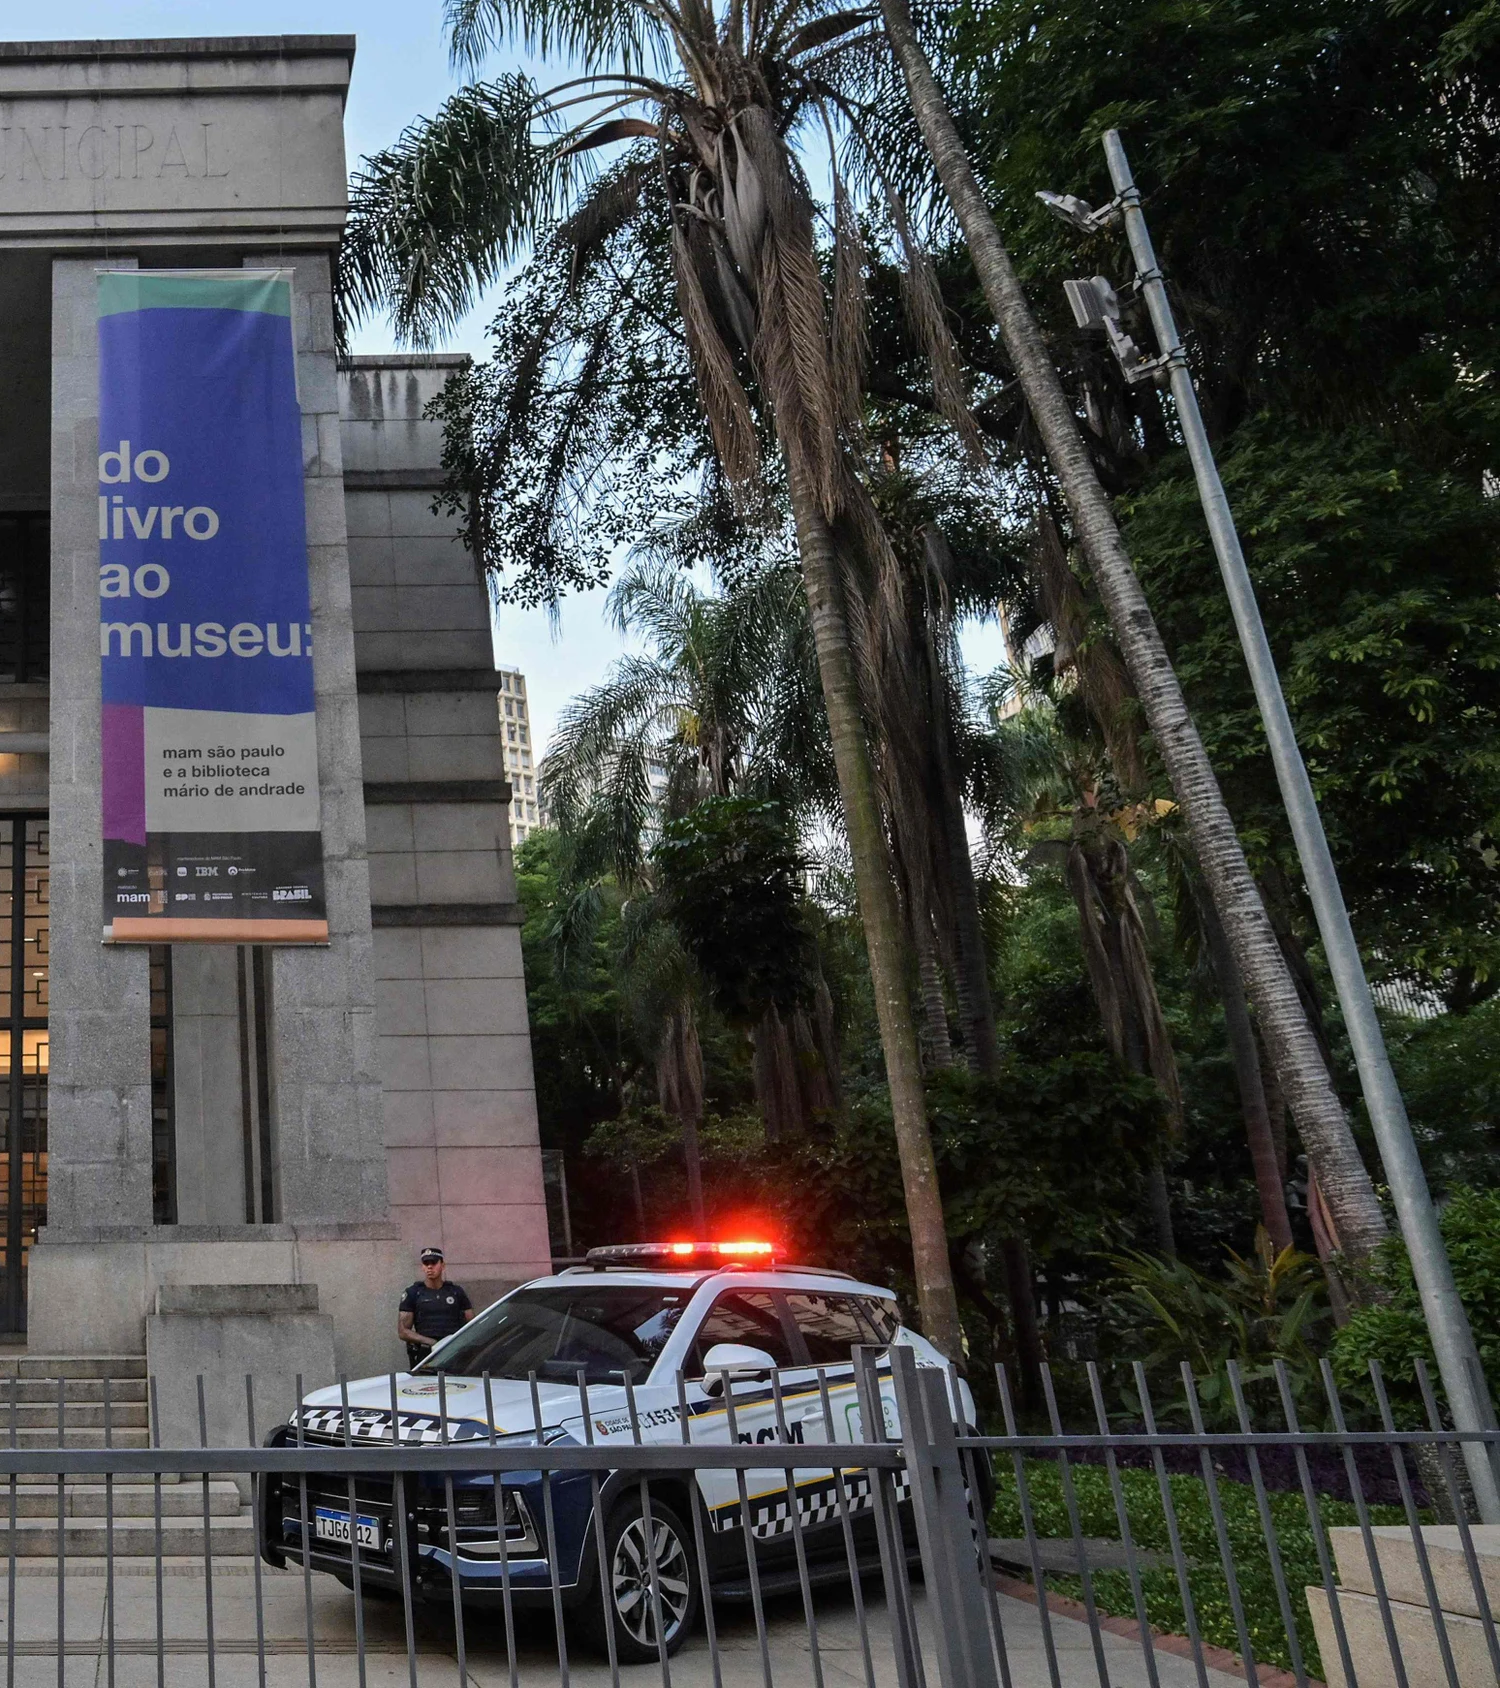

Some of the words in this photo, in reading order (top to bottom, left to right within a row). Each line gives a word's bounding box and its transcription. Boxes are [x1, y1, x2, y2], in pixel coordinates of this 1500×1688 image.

[98, 440, 170, 483] do
[99, 495, 220, 540] livro
[100, 563, 171, 599] ao
[163, 748, 202, 759] mam
[207, 746, 236, 759] são
[241, 744, 285, 760] paulo
[163, 768, 173, 778] e
[177, 768, 187, 778] a
[192, 765, 270, 778] biblioteca
[164, 784, 209, 797] mário
[214, 784, 234, 797] de
[239, 782, 305, 796] andrade
[195, 866, 219, 876] IBM
[117, 893, 150, 902] mam
[272, 889, 312, 900] BRASIL
[320, 1518, 372, 1544] TJG612
